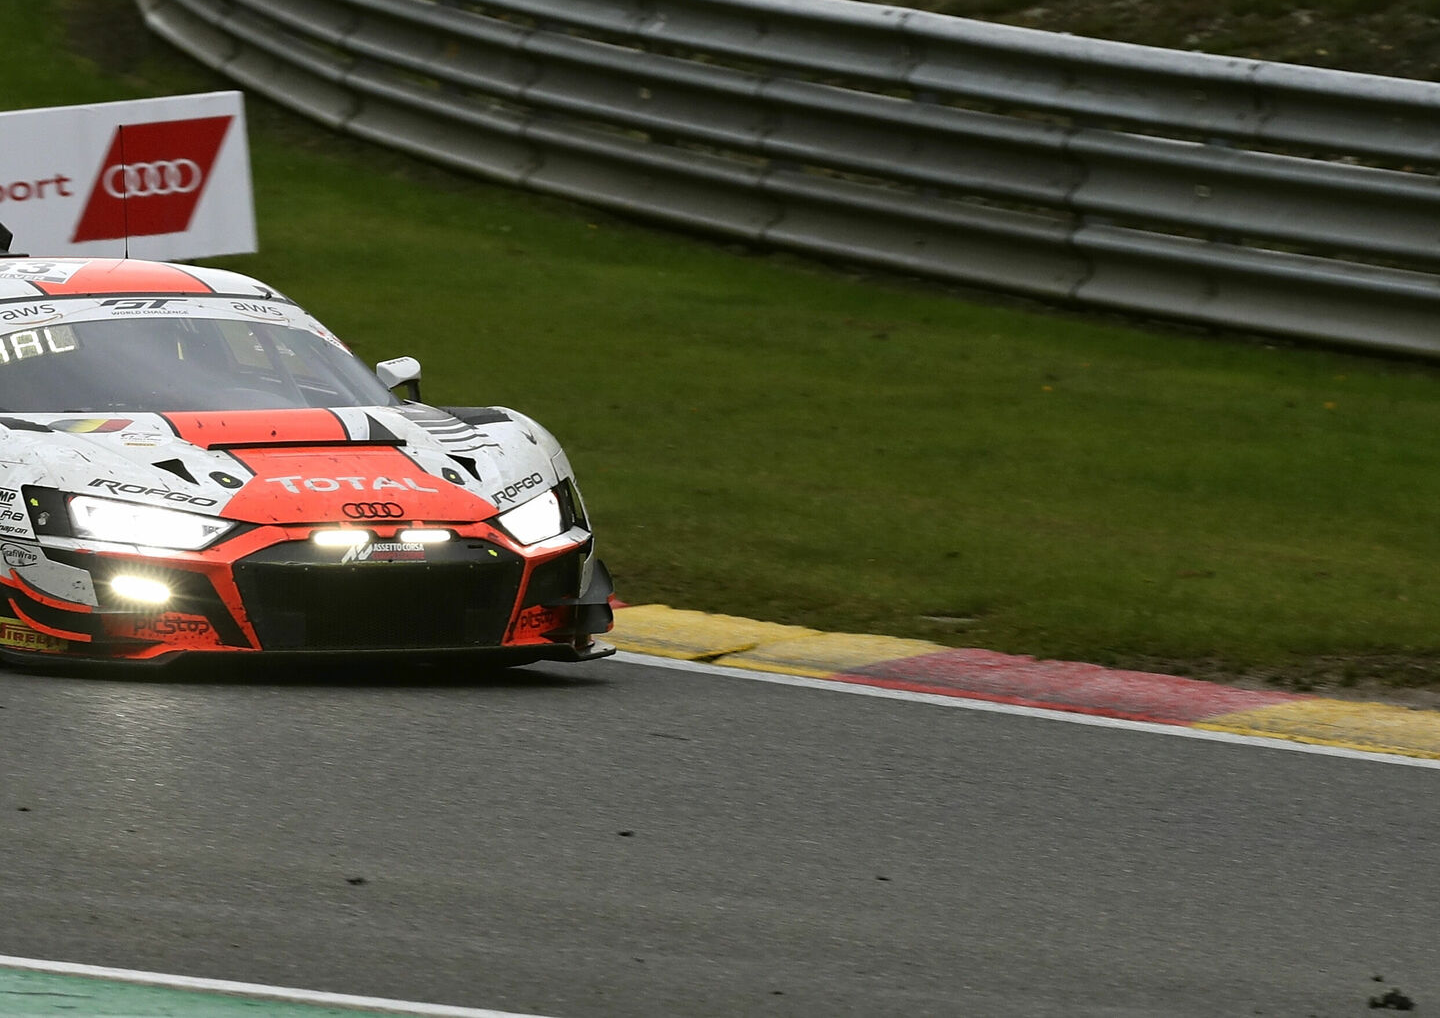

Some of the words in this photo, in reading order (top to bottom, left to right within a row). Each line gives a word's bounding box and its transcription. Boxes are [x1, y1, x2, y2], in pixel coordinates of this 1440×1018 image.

[100, 298, 188, 310] GT
[231, 301, 283, 316] aws
[0, 303, 56, 321] aws
[262, 475, 440, 493] TOTAL
[373, 543, 402, 551] ASSETTO
[402, 543, 425, 551] CORSA
